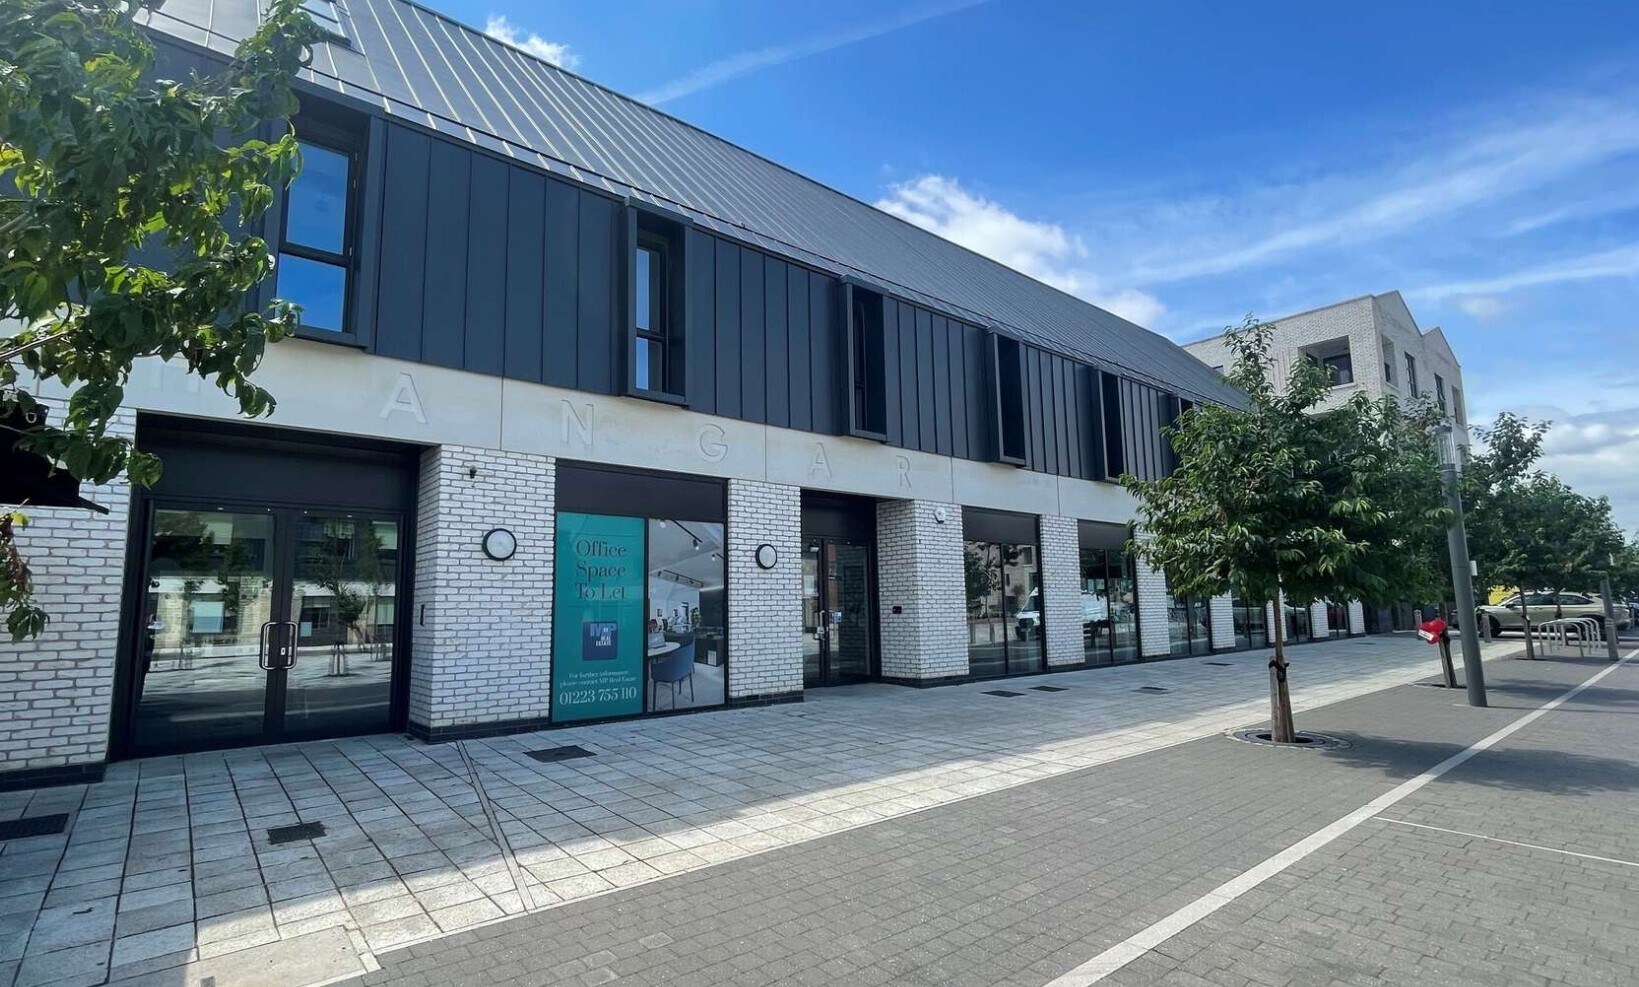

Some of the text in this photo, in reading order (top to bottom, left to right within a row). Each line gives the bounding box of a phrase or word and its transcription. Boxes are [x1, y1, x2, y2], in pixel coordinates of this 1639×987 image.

[576, 539, 627, 557] Office
[576, 560, 626, 582] Space
[575, 583, 625, 599] To Let
[560, 686, 637, 705] 01223 755 110
